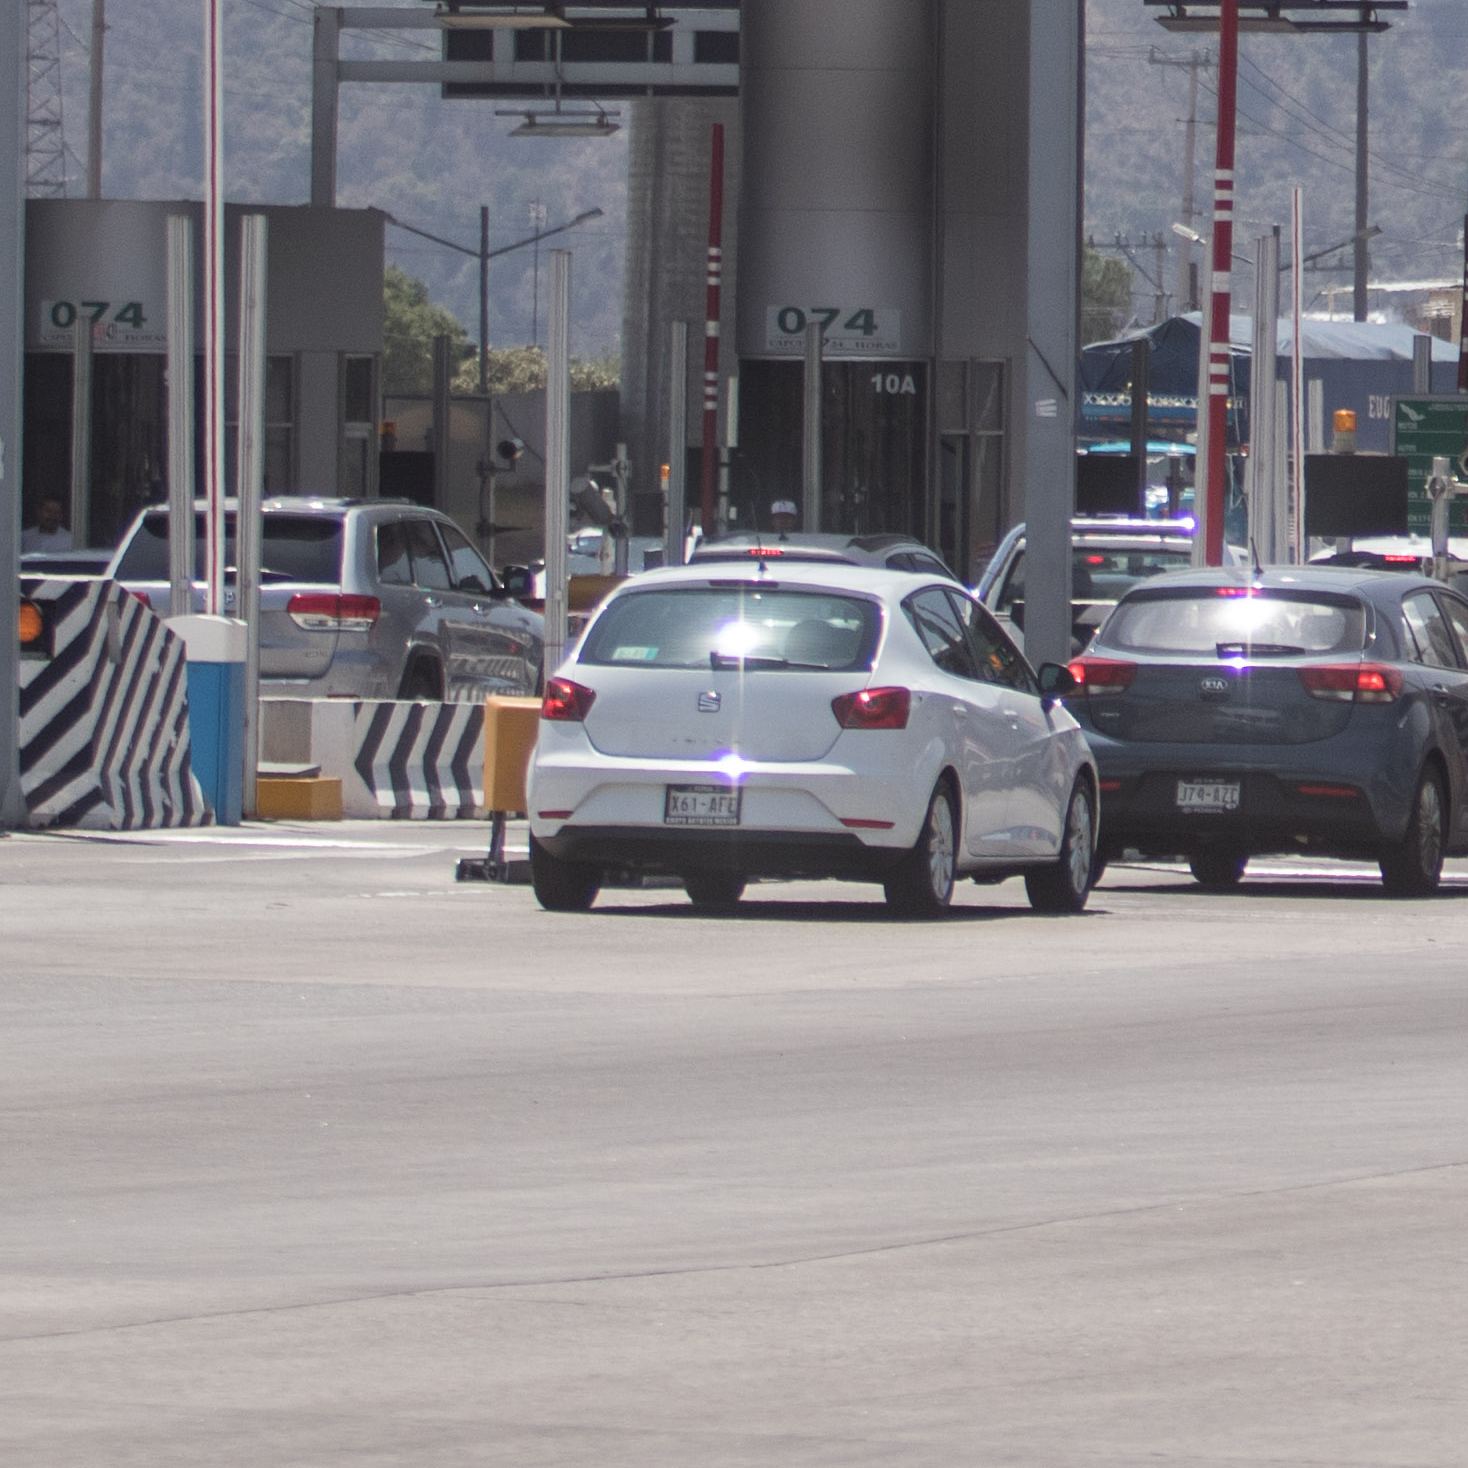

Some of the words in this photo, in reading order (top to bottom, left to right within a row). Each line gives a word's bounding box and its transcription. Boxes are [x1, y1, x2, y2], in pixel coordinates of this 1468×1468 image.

[51, 302, 147, 329] 074
[777, 307, 878, 336] 074
[871, 373, 916, 395] 10A
